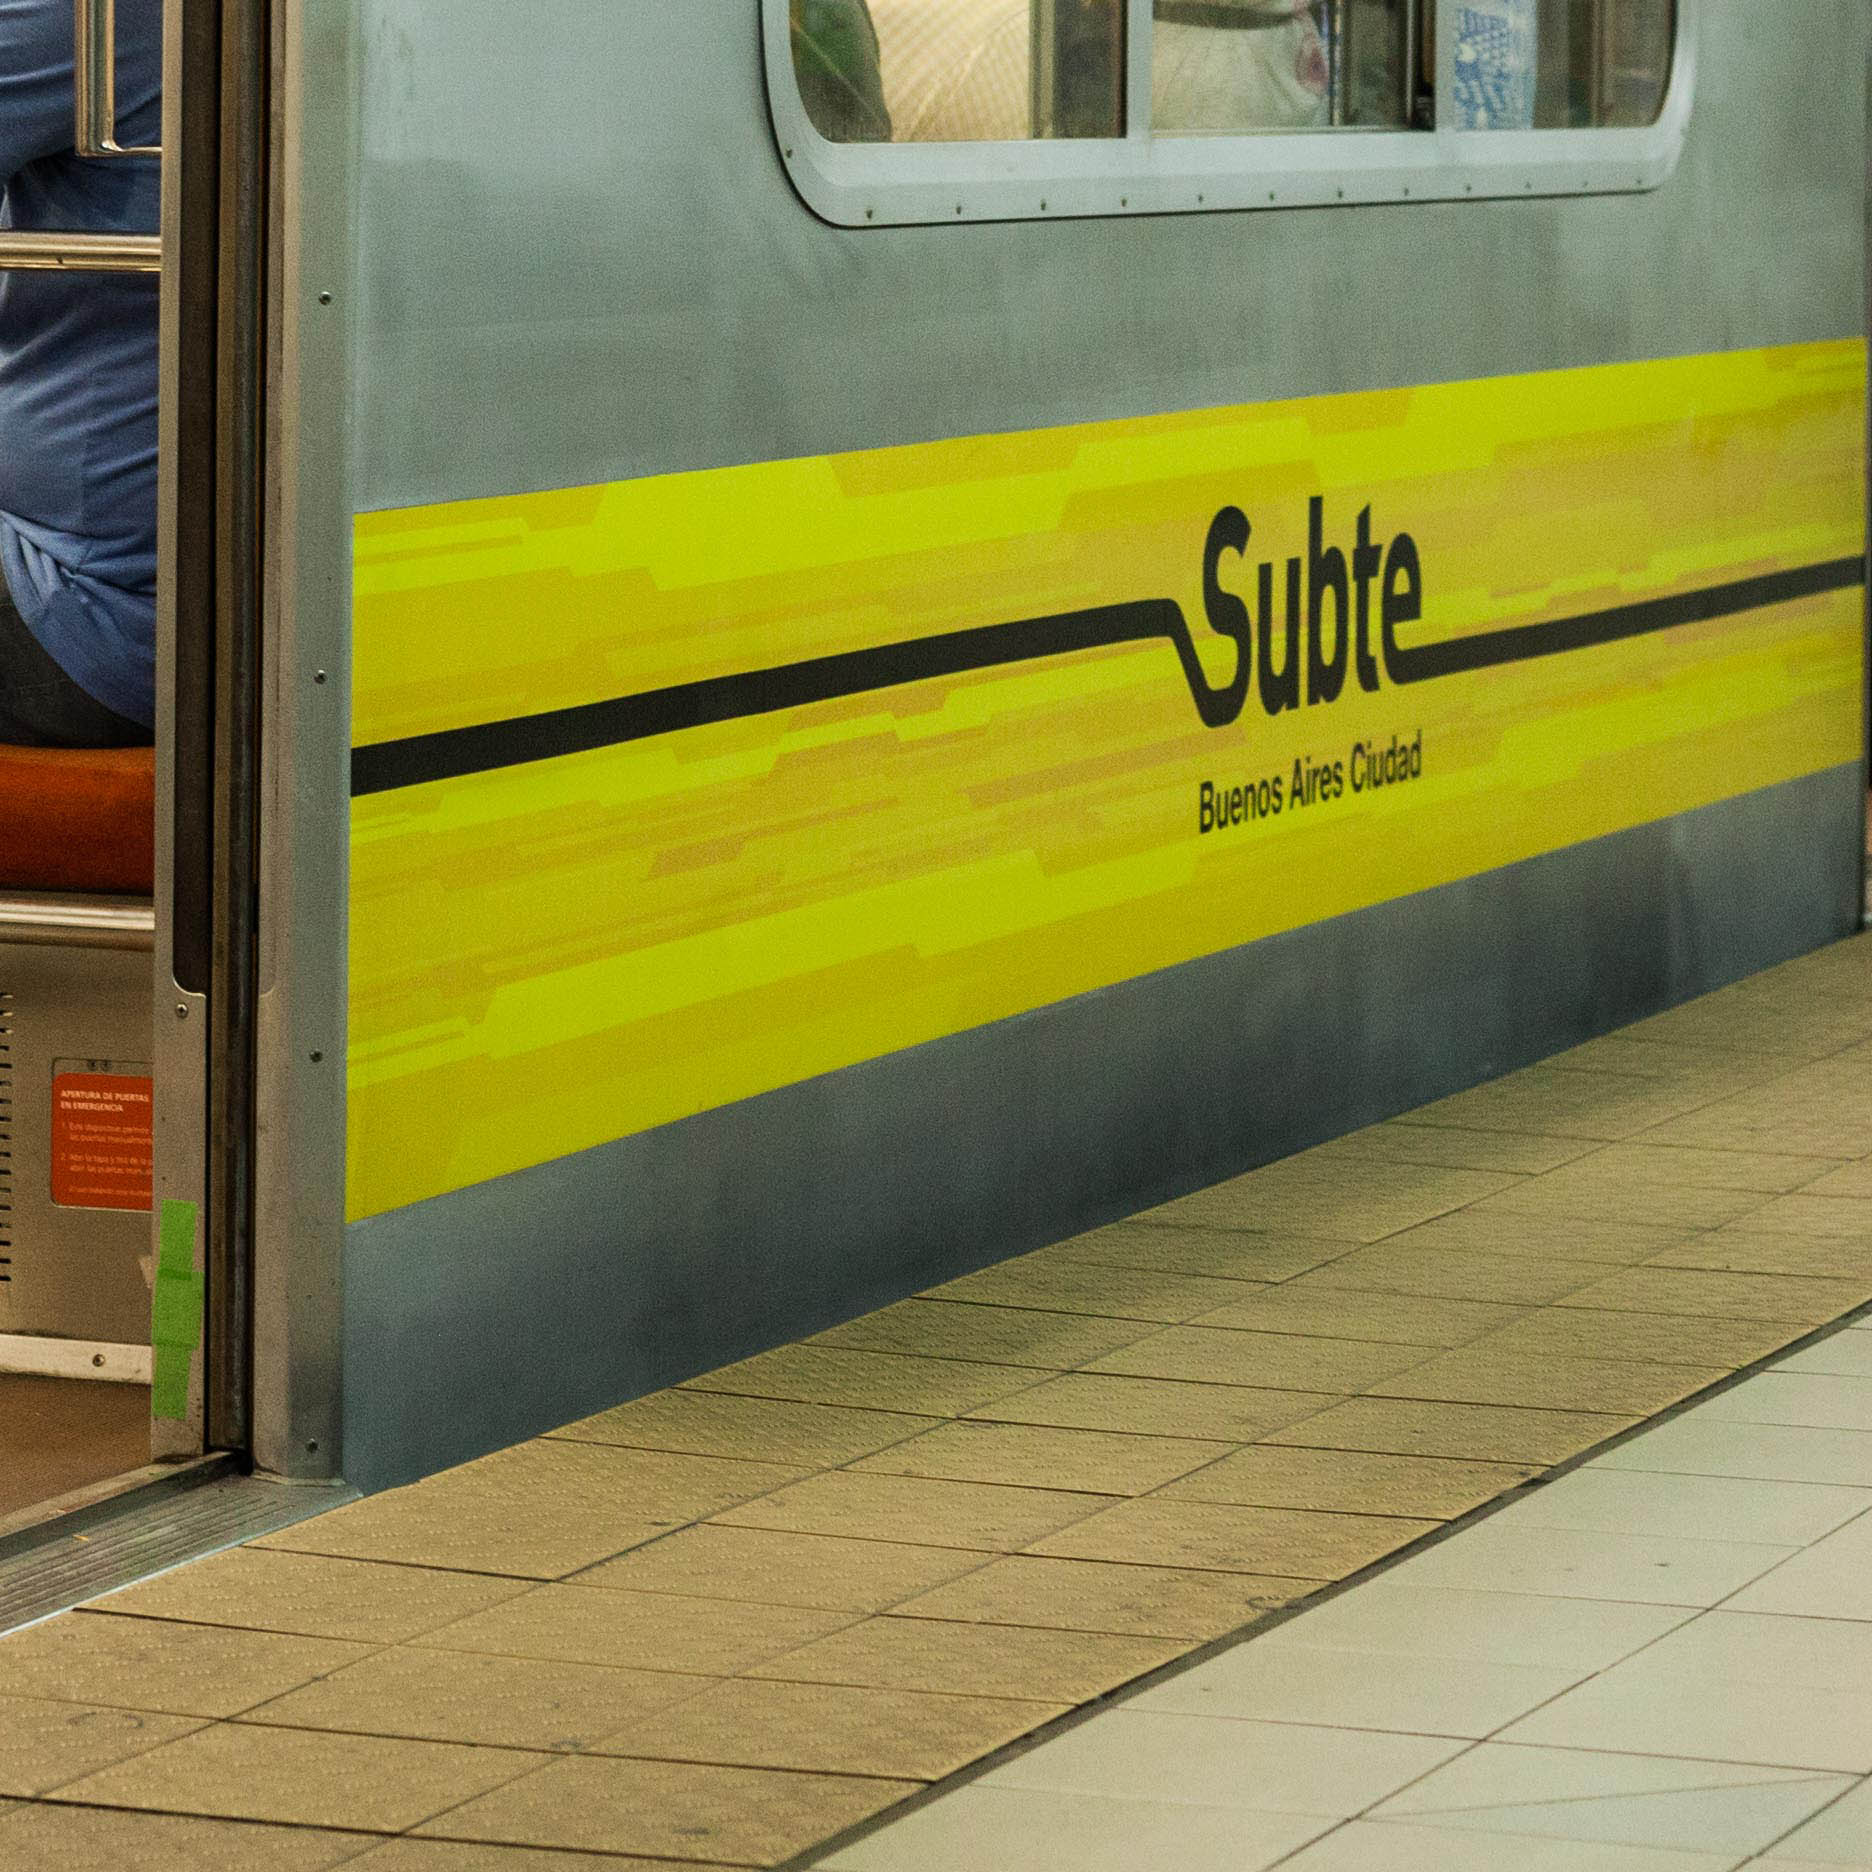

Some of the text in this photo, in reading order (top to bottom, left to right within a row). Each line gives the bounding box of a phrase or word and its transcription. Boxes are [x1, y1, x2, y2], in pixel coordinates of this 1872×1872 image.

[1196, 495, 1423, 728] Subte
[1199, 728, 1422, 834] Buenos Aires Ciudad
